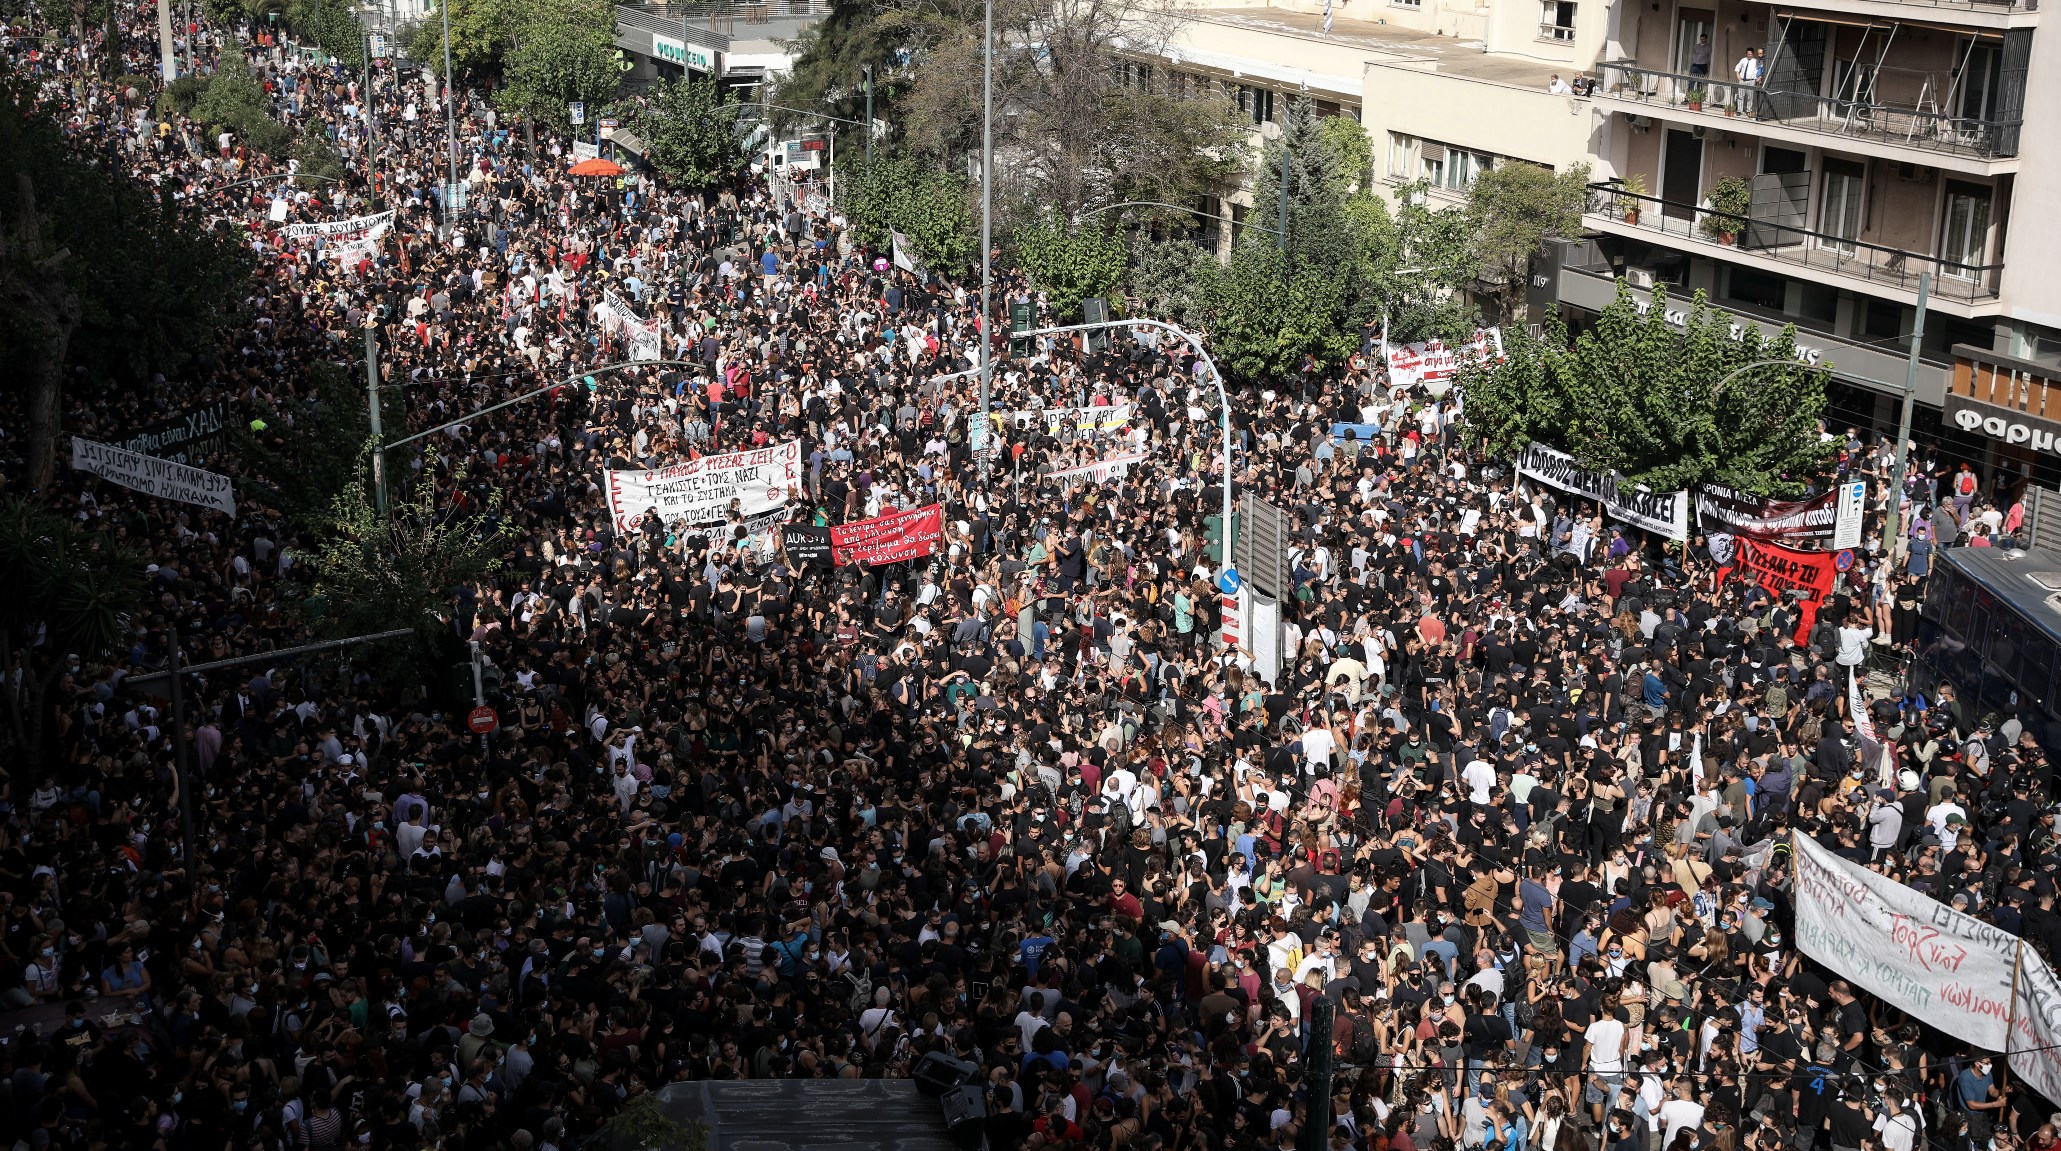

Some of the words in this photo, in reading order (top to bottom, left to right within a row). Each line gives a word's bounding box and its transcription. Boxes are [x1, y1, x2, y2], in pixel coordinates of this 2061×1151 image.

[1533, 275, 1547, 289] 119
[1095, 410, 1117, 422] ART
[660, 460, 700, 479] ΠΑΥΛΟΣ
[705, 453, 745, 470] ΦΥΣΣΑΣ
[646, 476, 700, 497] ΤΣΑΚΙΣΤΕ
[706, 471, 730, 486] ΤΟΥΣ
[735, 466, 759, 484] ΝΑΖΙ
[663, 494, 679, 507] ΚΑΙ
[682, 493, 694, 504] ΤΟ
[697, 485, 738, 502] ΣΥΣΤΗΜΑ
[684, 506, 706, 522] ΤΟΥΣ
[879, 518, 895, 527] σας
[1806, 501, 1837, 527] καταδί
[1809, 1074, 1825, 1095] 4
